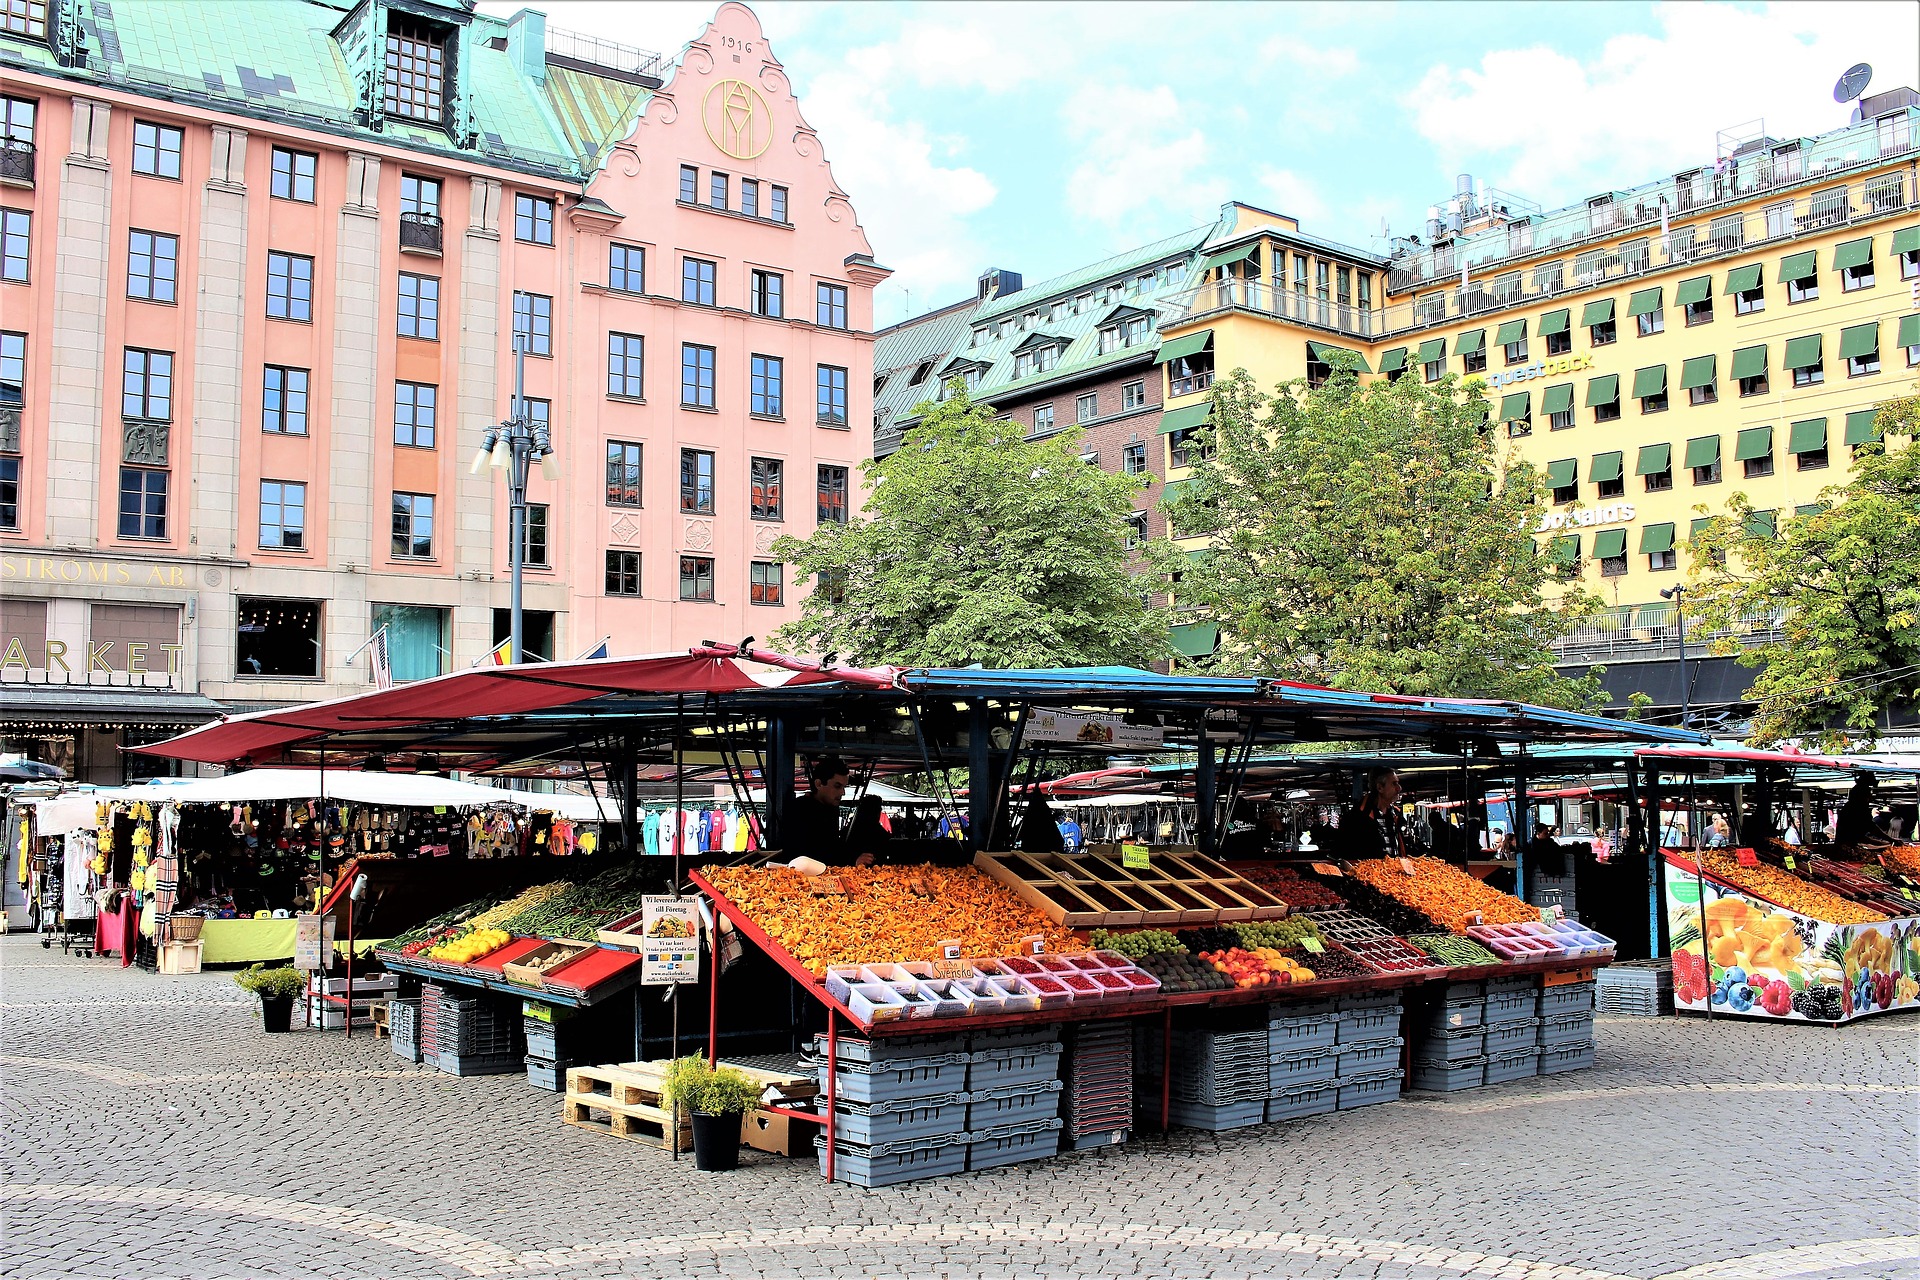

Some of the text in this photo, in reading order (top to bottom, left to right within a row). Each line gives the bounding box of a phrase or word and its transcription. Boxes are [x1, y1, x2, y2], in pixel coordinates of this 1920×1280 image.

[721, 35, 752, 54] 1916
[1490, 351, 1595, 391] questback
[1518, 502, 1636, 533] Donald's
[147, 565, 186, 586] A.B.
[0, 636, 184, 675] ARKET
[665, 905, 687, 914] Företag
